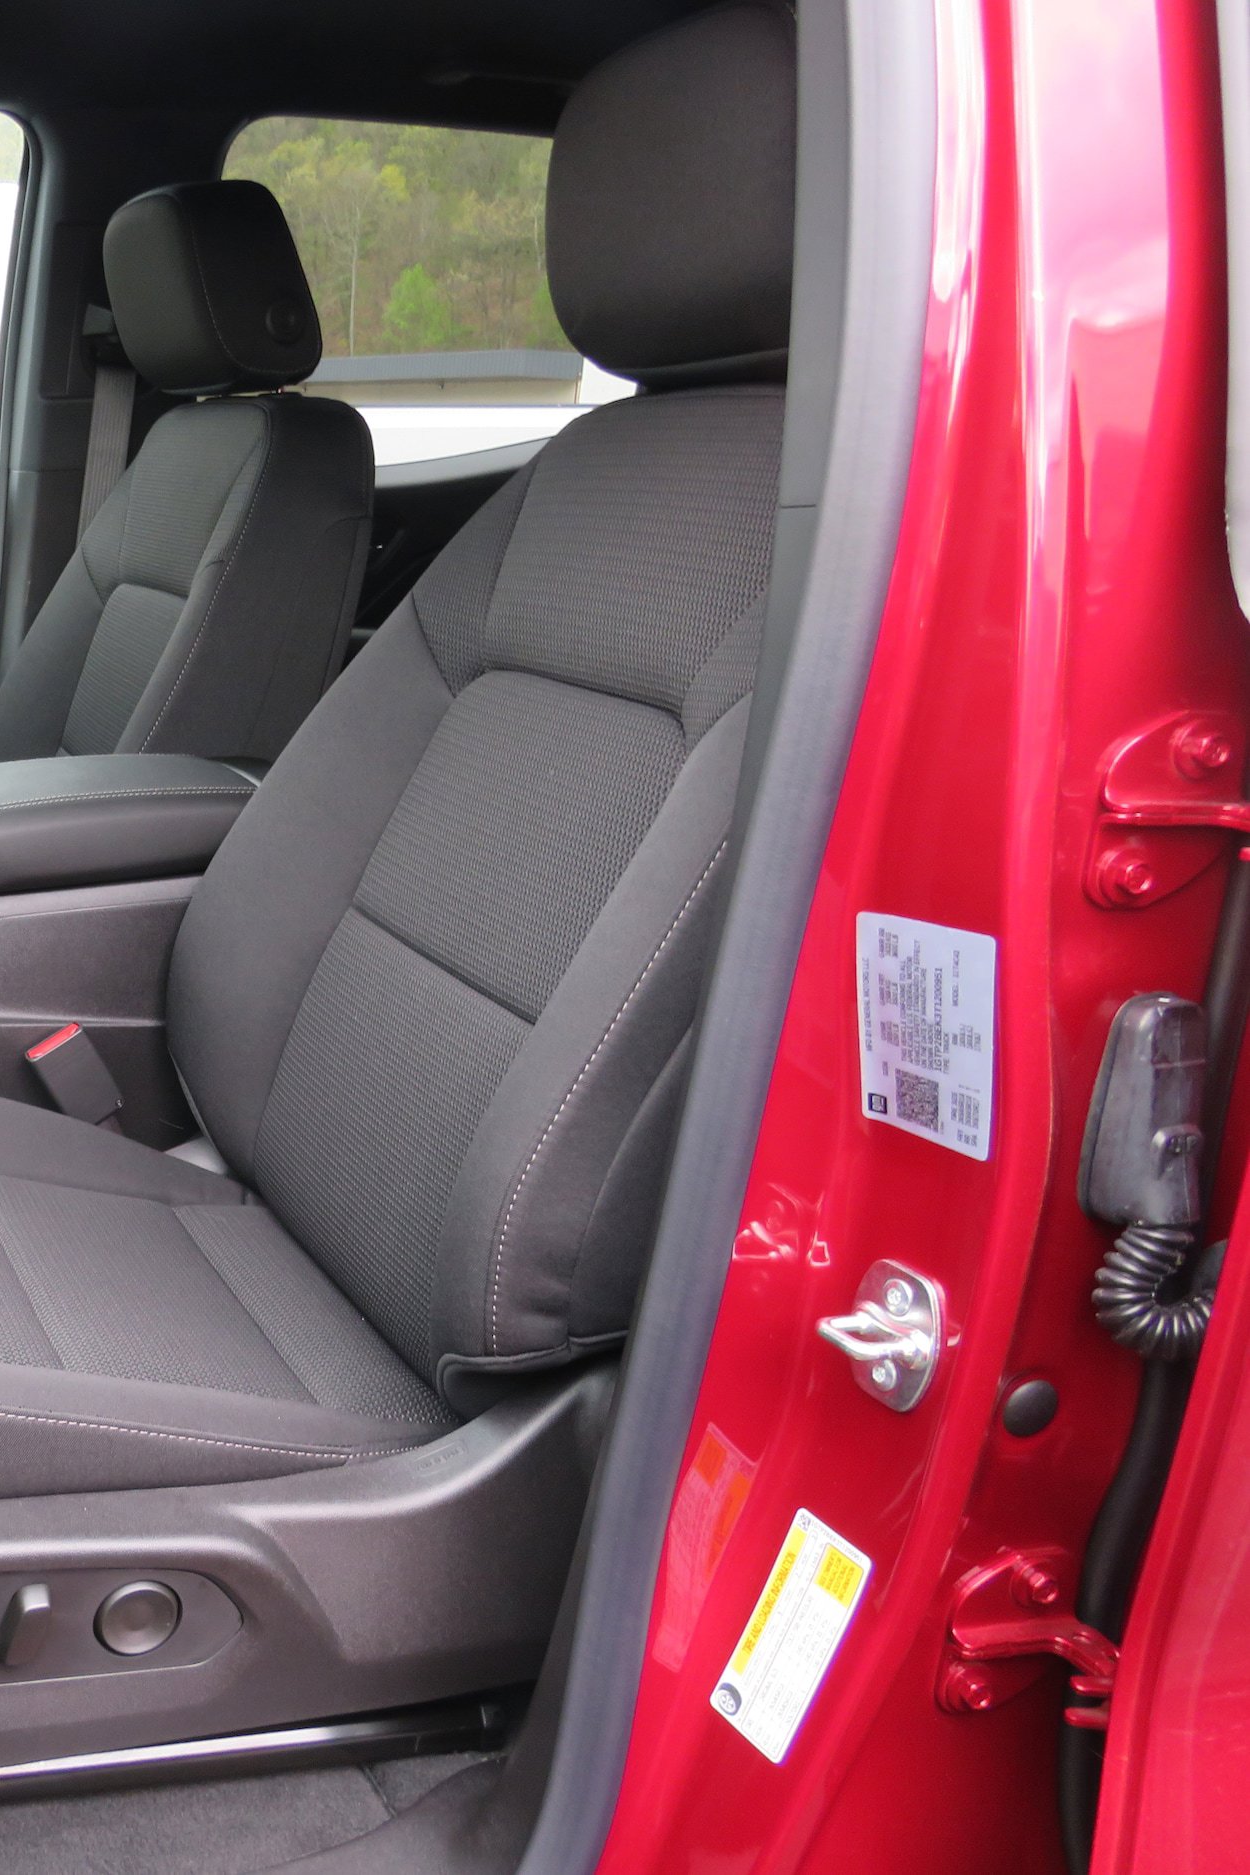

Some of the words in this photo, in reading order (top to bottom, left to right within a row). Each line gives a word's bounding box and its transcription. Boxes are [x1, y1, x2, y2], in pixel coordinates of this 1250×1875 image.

[861, 956, 869, 970] LLC
[862, 970, 870, 998] MOTORS
[863, 998, 871, 1029] GENERAL
[769, 1549, 797, 1598] INFORMATION
[755, 1592, 777, 1627] LOADING
[748, 1620, 763, 1640] AND
[741, 1636, 756, 1656] TIRE
